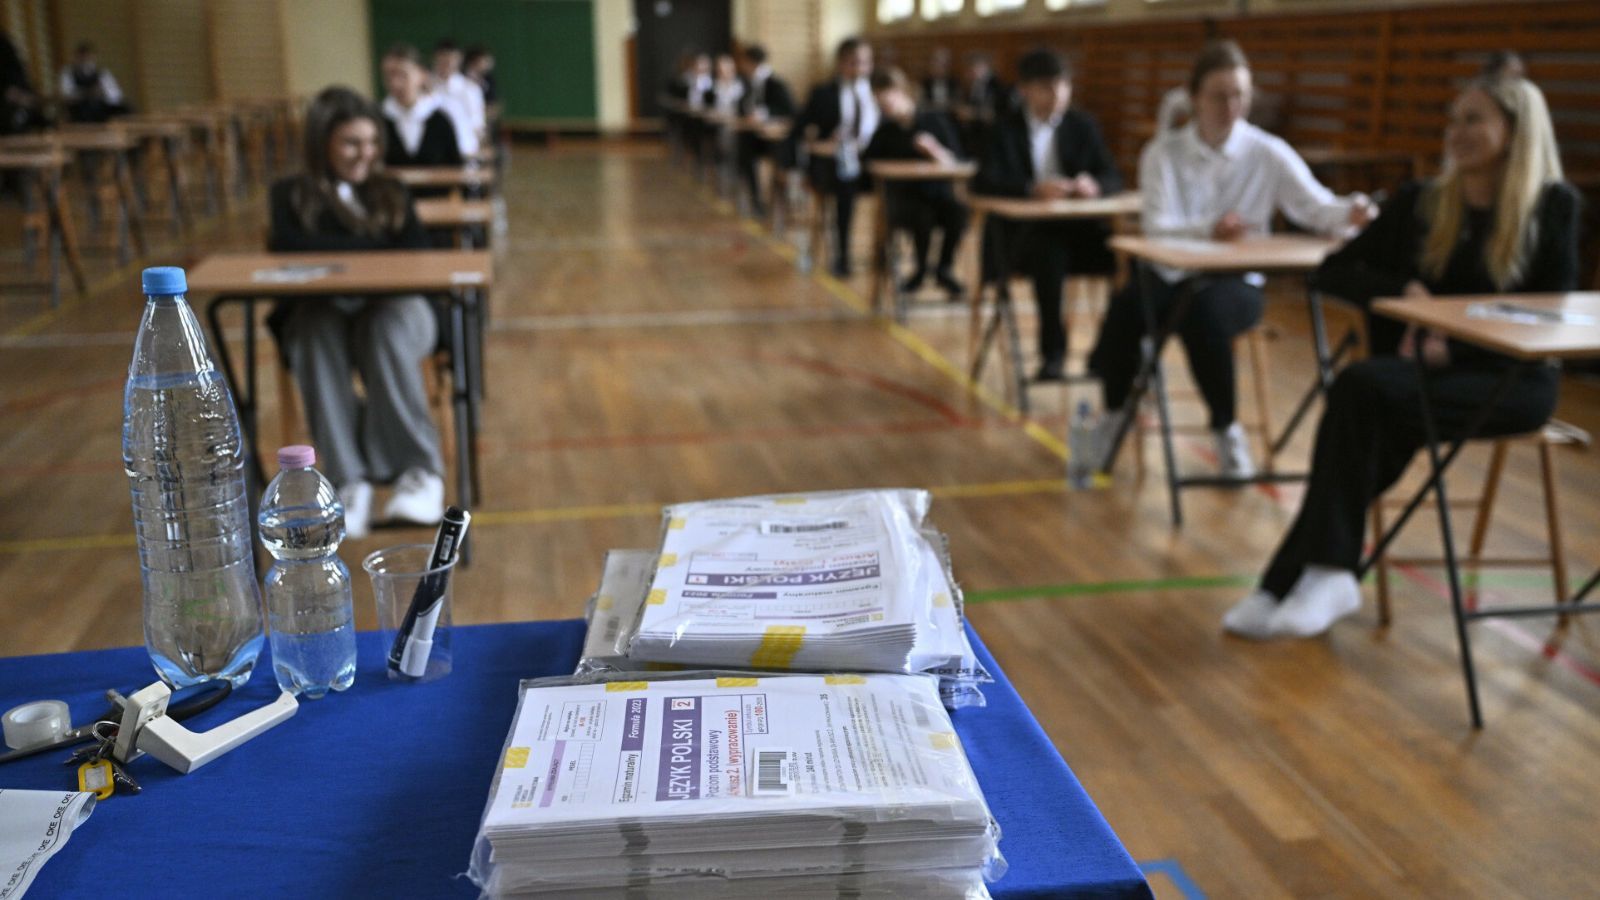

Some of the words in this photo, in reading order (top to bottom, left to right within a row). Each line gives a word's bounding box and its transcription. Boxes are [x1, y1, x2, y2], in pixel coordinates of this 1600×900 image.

[723, 574, 803, 584] POLSKI
[809, 566, 876, 583] JĘZYK
[631, 700, 643, 713] 2023
[628, 713, 640, 739] Formuła
[725, 710, 742, 767] (wypracowanie)
[671, 719, 693, 765] POLSKI
[706, 730, 722, 773] podstawowy
[625, 753, 639, 780] maturalny
[619, 780, 634, 803] Egzamin
[668, 766, 696, 800] JĘZYK
[705, 773, 720, 799] Poziom
[46, 821, 58, 836] CKE
[54, 806, 66, 819] CKE
